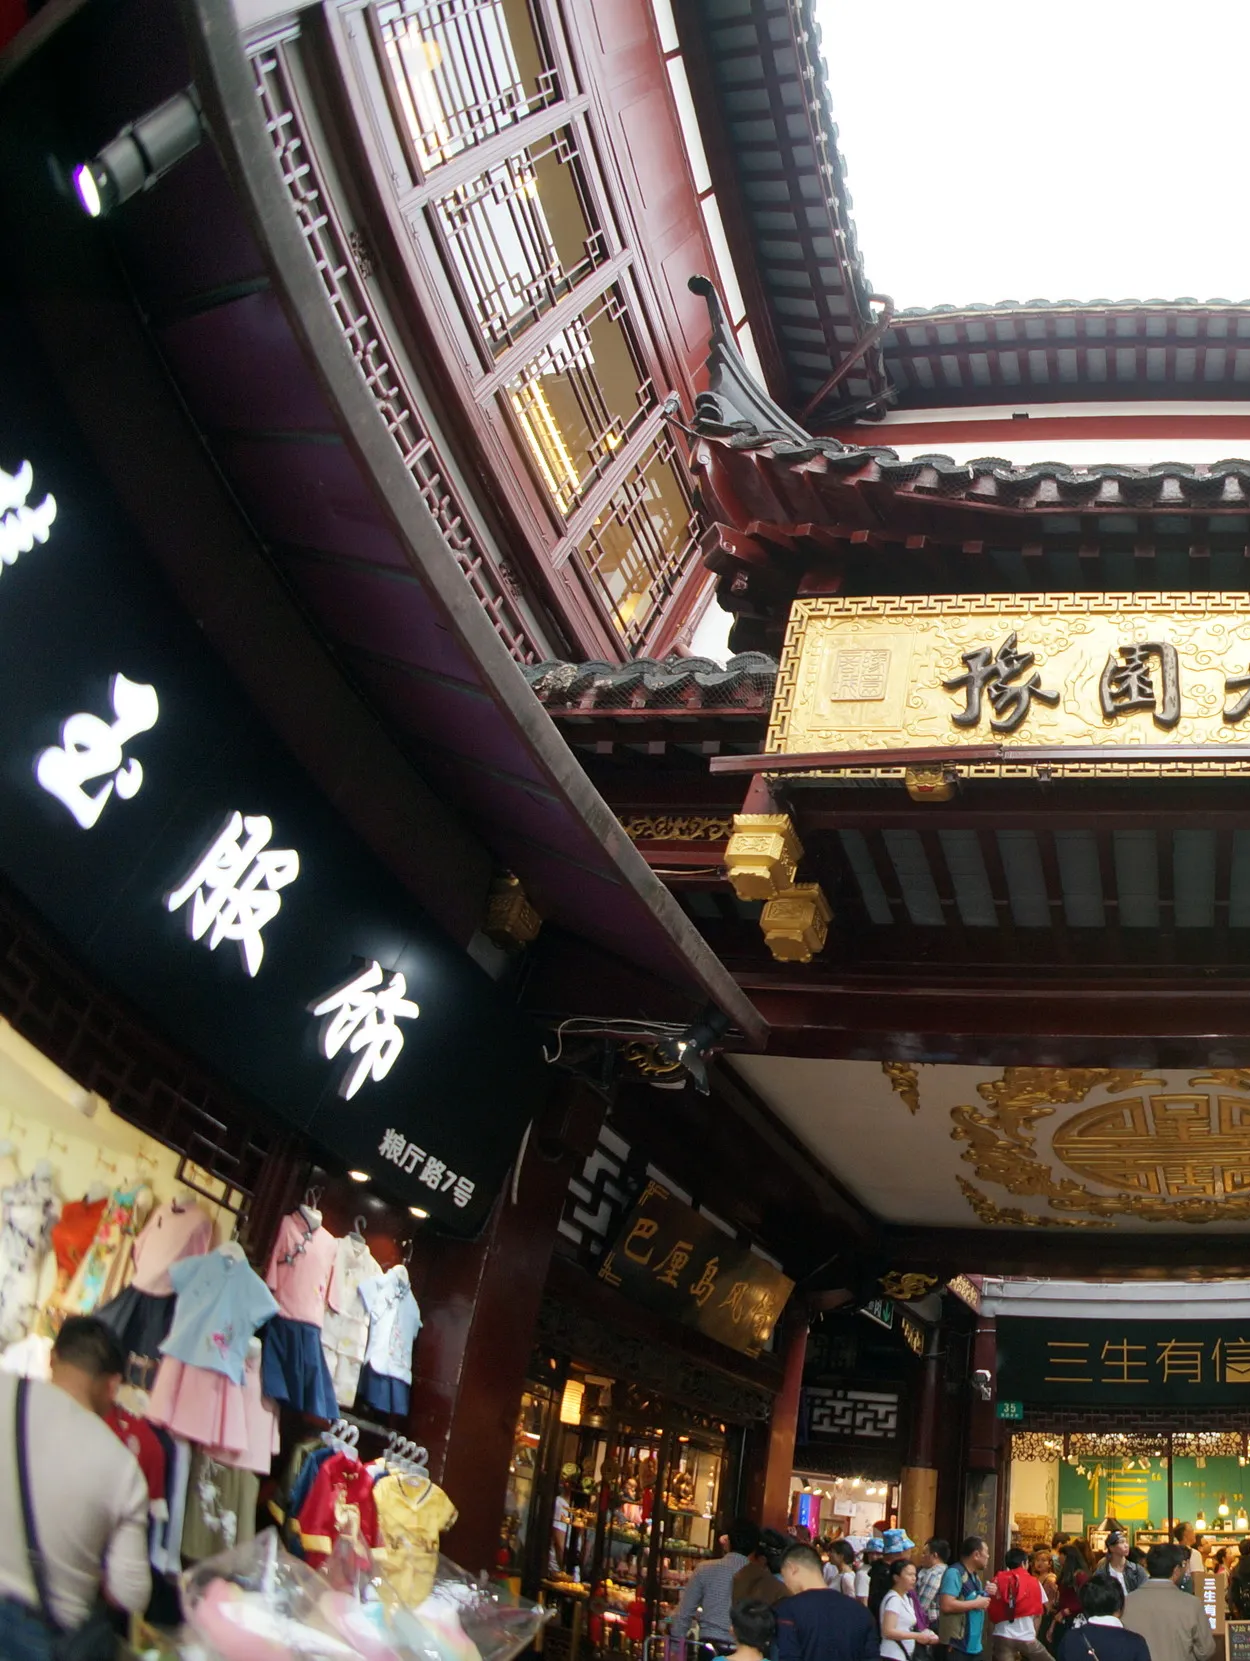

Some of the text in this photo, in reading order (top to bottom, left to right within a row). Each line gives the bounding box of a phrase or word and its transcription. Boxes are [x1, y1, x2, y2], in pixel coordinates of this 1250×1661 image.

[378, 1128, 476, 1208] 粮厅路7号
[1003, 1402, 1016, 1413] 35
